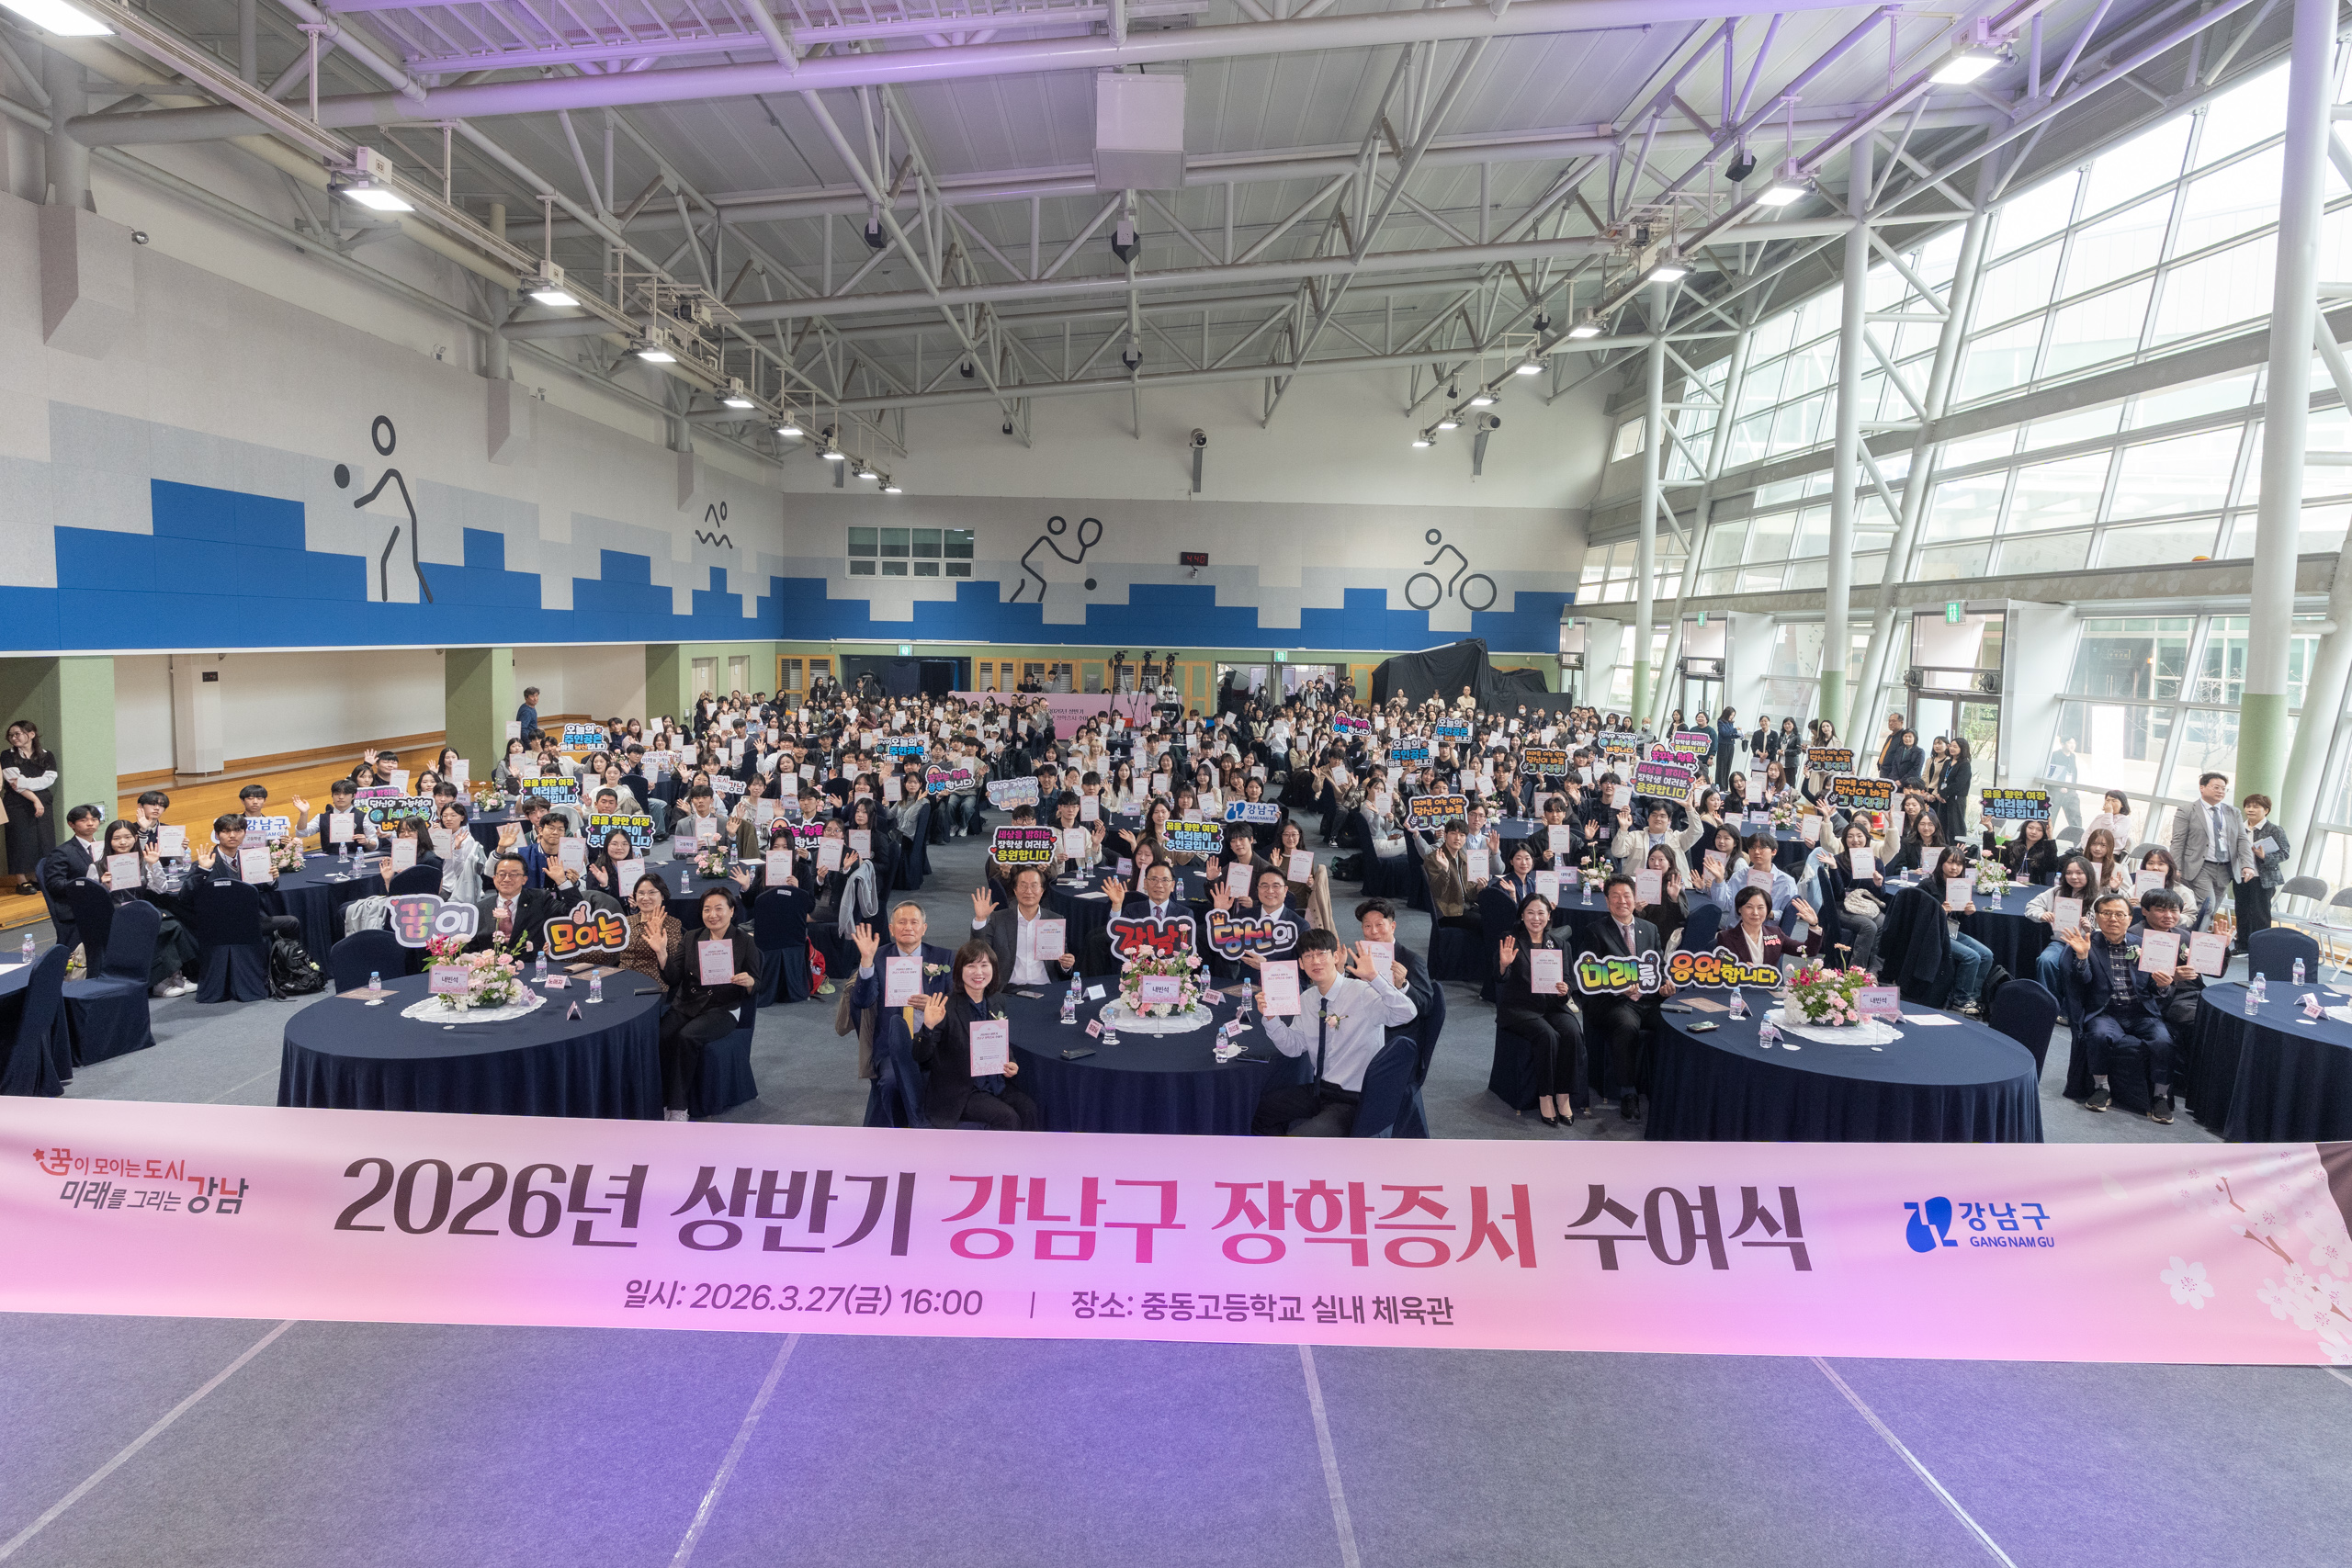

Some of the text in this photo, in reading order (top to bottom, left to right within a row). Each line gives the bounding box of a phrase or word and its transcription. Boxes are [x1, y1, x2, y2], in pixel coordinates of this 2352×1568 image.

[1438, 718, 1463, 728] 오늘의
[565, 724, 595, 735] 오늘의
[1437, 727, 1468, 736] 주인공은
[564, 734, 603, 745] 주인공은
[891, 737, 918, 747] 오늘의
[1393, 739, 1421, 750] 오늘의
[560, 743, 606, 751] 바로 당신입니다
[889, 746, 924, 756] 주인공은
[1674, 744, 1706, 754] 응원합니다
[1391, 749, 1430, 760] 주인공은
[1835, 755, 1850, 763] 바로
[1388, 759, 1433, 767] 바로 당신입니다
[1529, 762, 1537, 772] 그
[1813, 761, 1822, 770] 그
[1638, 763, 1663, 775] 세상을
[1665, 766, 1690, 779] 밝히는
[523, 777, 575, 788] 꿈을 향한 여정
[928, 779, 974, 794] 응원합니다
[1637, 773, 1690, 788] 장학생 여러분,
[531, 785, 569, 796] 여러분이
[729, 782, 745, 793] 강남
[1635, 782, 1687, 799] 응원합니다
[1835, 785, 1890, 798] 당신이 바로
[1838, 795, 1849, 806] 그
[1983, 789, 2046, 801] 꿈을 향한 여정
[369, 798, 396, 809] 당신의
[1247, 803, 1277, 816] 강남구
[1993, 798, 2039, 809] 여러분이
[1413, 804, 1464, 817] 당신이 바로
[1984, 807, 2049, 820] 주인공입니다
[246, 818, 288, 832] 강남구
[591, 815, 650, 827] 꿈을 향한 여정
[1166, 821, 1219, 833] 꿈을 향한 여정
[1419, 815, 1429, 827] 그
[998, 829, 1051, 840] 세상을 밝히는
[1174, 830, 1212, 842] 여러분이
[997, 840, 1053, 851] 장학생 여러분,
[1166, 840, 1220, 852] 주인공입니다
[997, 849, 1051, 863] 응원합니다
[400, 902, 469, 939] 꿈이
[550, 916, 624, 953] 모이는
[1213, 921, 1293, 953] 당신의
[1580, 960, 1656, 987] 미래를
[1670, 954, 1778, 984] 응원합니다
[441, 976, 458, 984] 내빈석
[1152, 986, 1170, 995] 내빈석
[1869, 997, 1888, 1005] 내빈석
[49, 1147, 185, 1182] 꿈이 모이는 도시
[60, 1176, 251, 1215] 미래를 그리는 강남
[334, 1156, 1813, 1271] 2026년 상반기 강남구 장학증서 수여식
[1958, 1201, 2052, 1232] 강남구
[1969, 1235, 2056, 1248] GANG NAM GU
[623, 1278, 983, 1317] 일시: 2026.3.27(금) 16:00
[1070, 1290, 1455, 1326] 장소: 중동고등학교 실내 체육관
